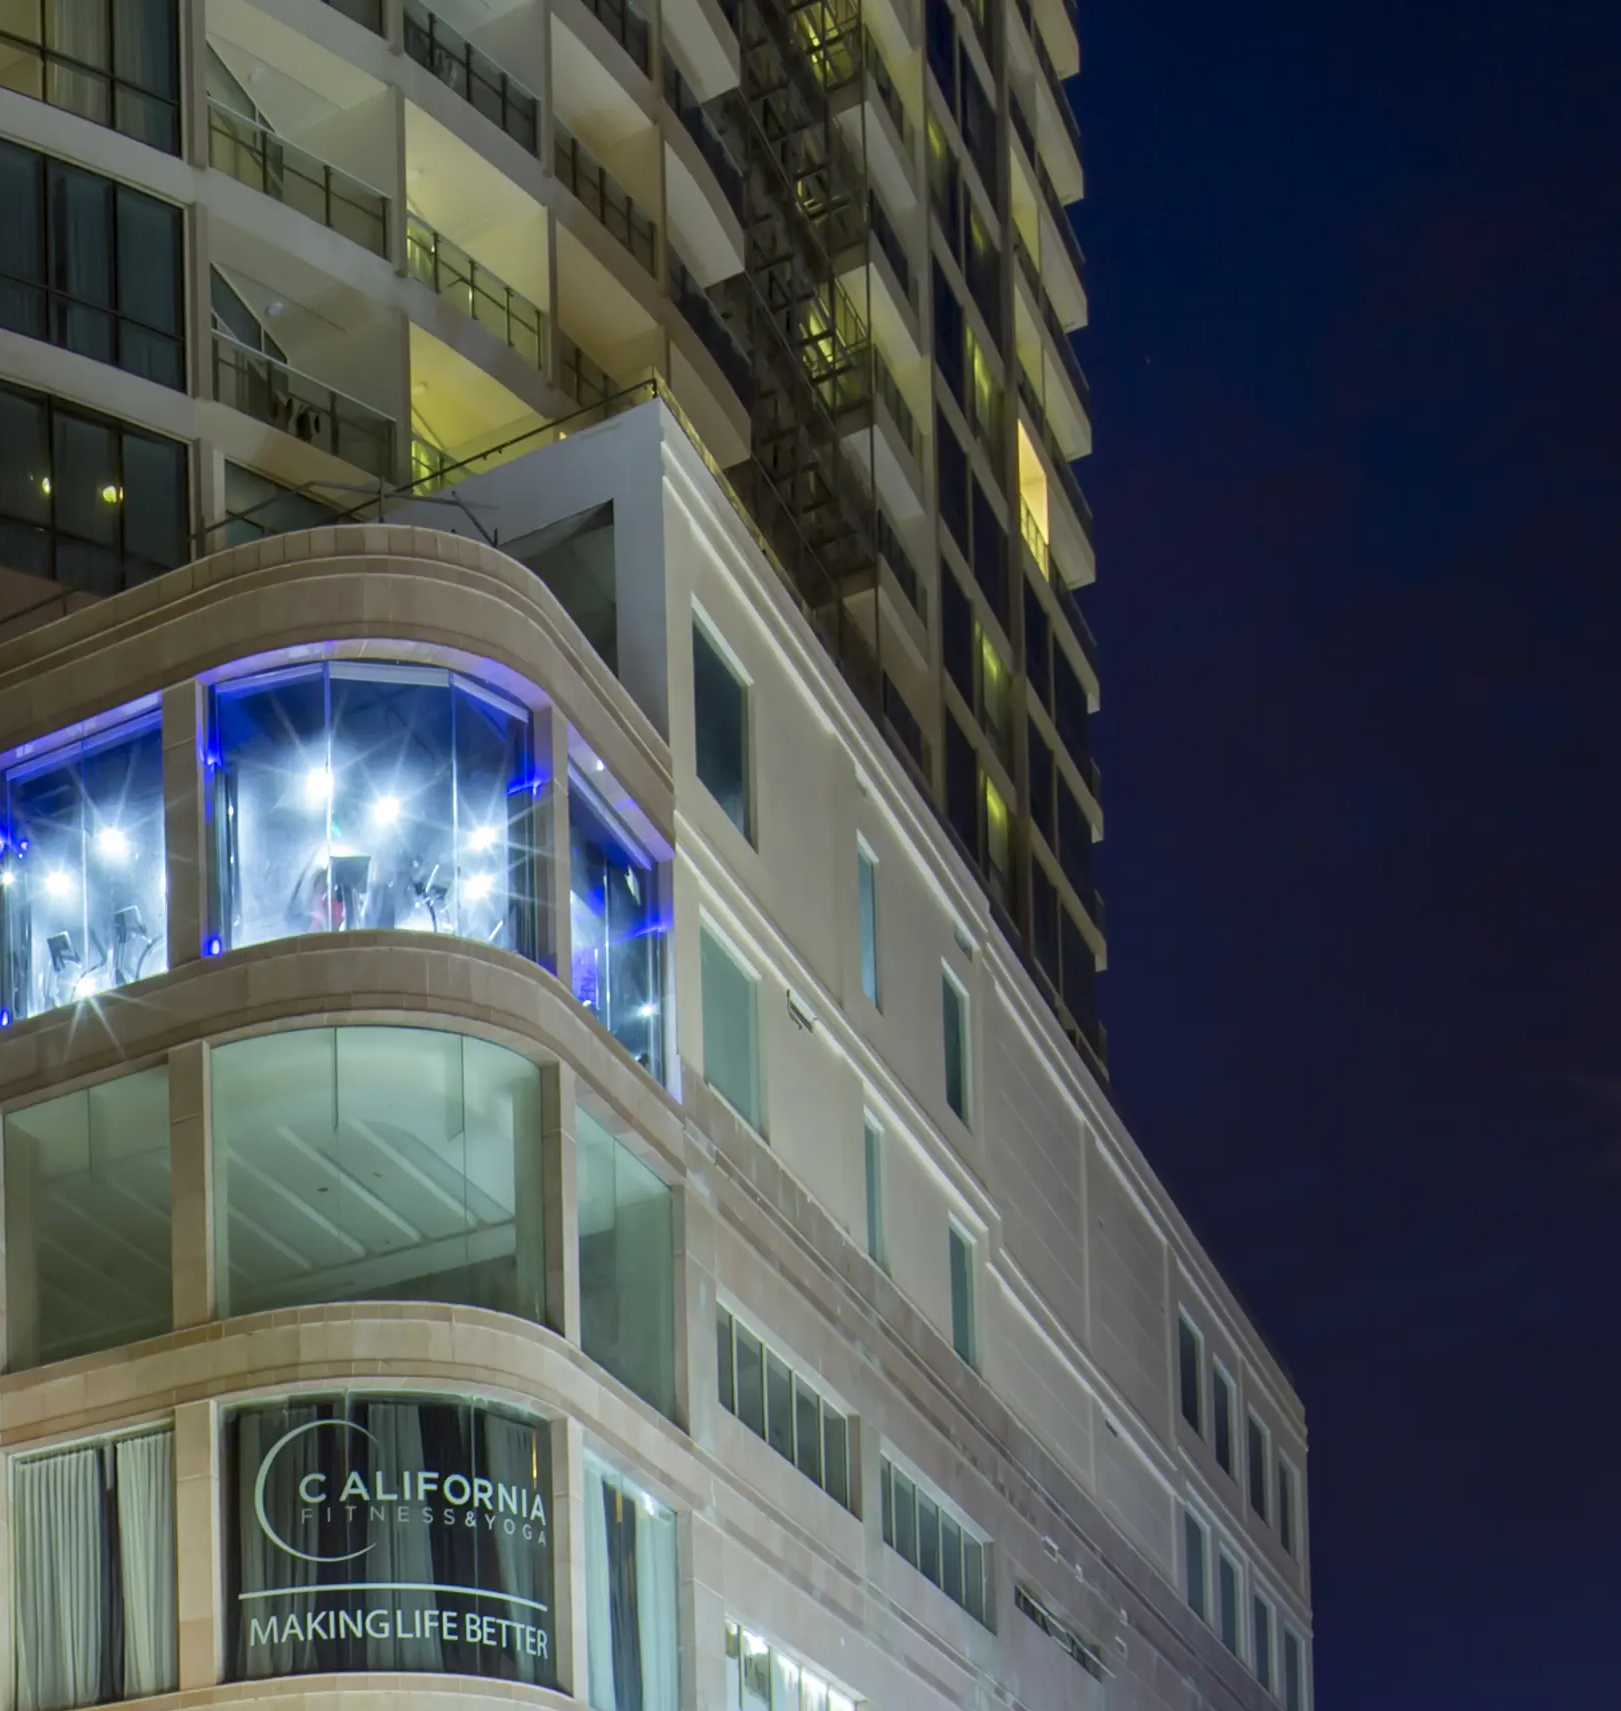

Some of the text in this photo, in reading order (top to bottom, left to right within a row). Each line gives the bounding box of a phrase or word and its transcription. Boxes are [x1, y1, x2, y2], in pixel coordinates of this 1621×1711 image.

[298, 1470, 547, 1527] CALIFORNIA
[248, 1608, 549, 1660] MAKING LIFE BETTER
